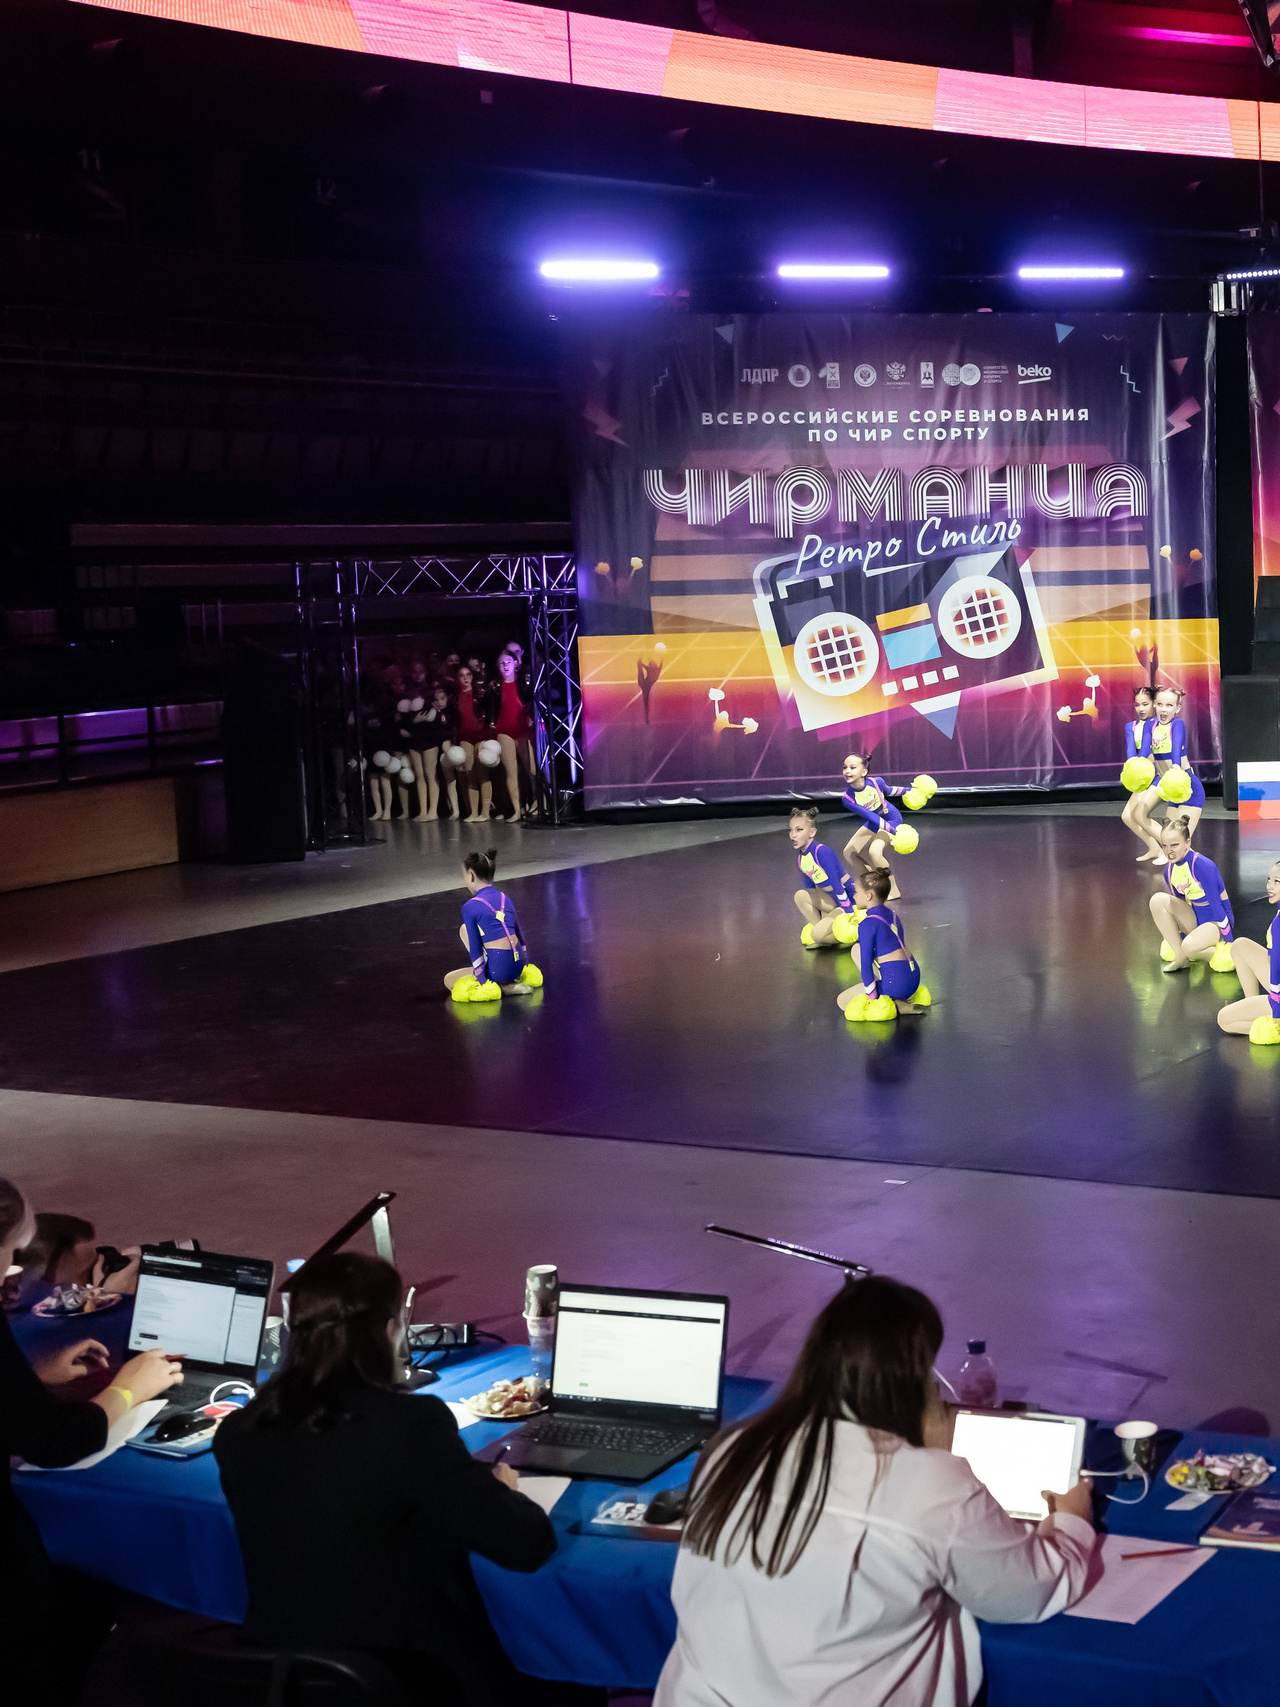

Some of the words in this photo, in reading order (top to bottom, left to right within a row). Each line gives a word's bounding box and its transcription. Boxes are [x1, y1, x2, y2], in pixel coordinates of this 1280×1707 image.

[740, 368, 780, 385] ЛДПР
[1017, 364, 1052, 377] beko
[701, 407, 899, 426] ВСЕРОССИЙСКИЕ
[909, 408, 1090, 423] СОРЕВНОВАНИЯ
[808, 429, 838, 443] ПО
[848, 429, 893, 442] ЧИР
[902, 427, 990, 441] СПОРТУ
[795, 534, 903, 575] Ретро
[916, 516, 1022, 556] Стиль
